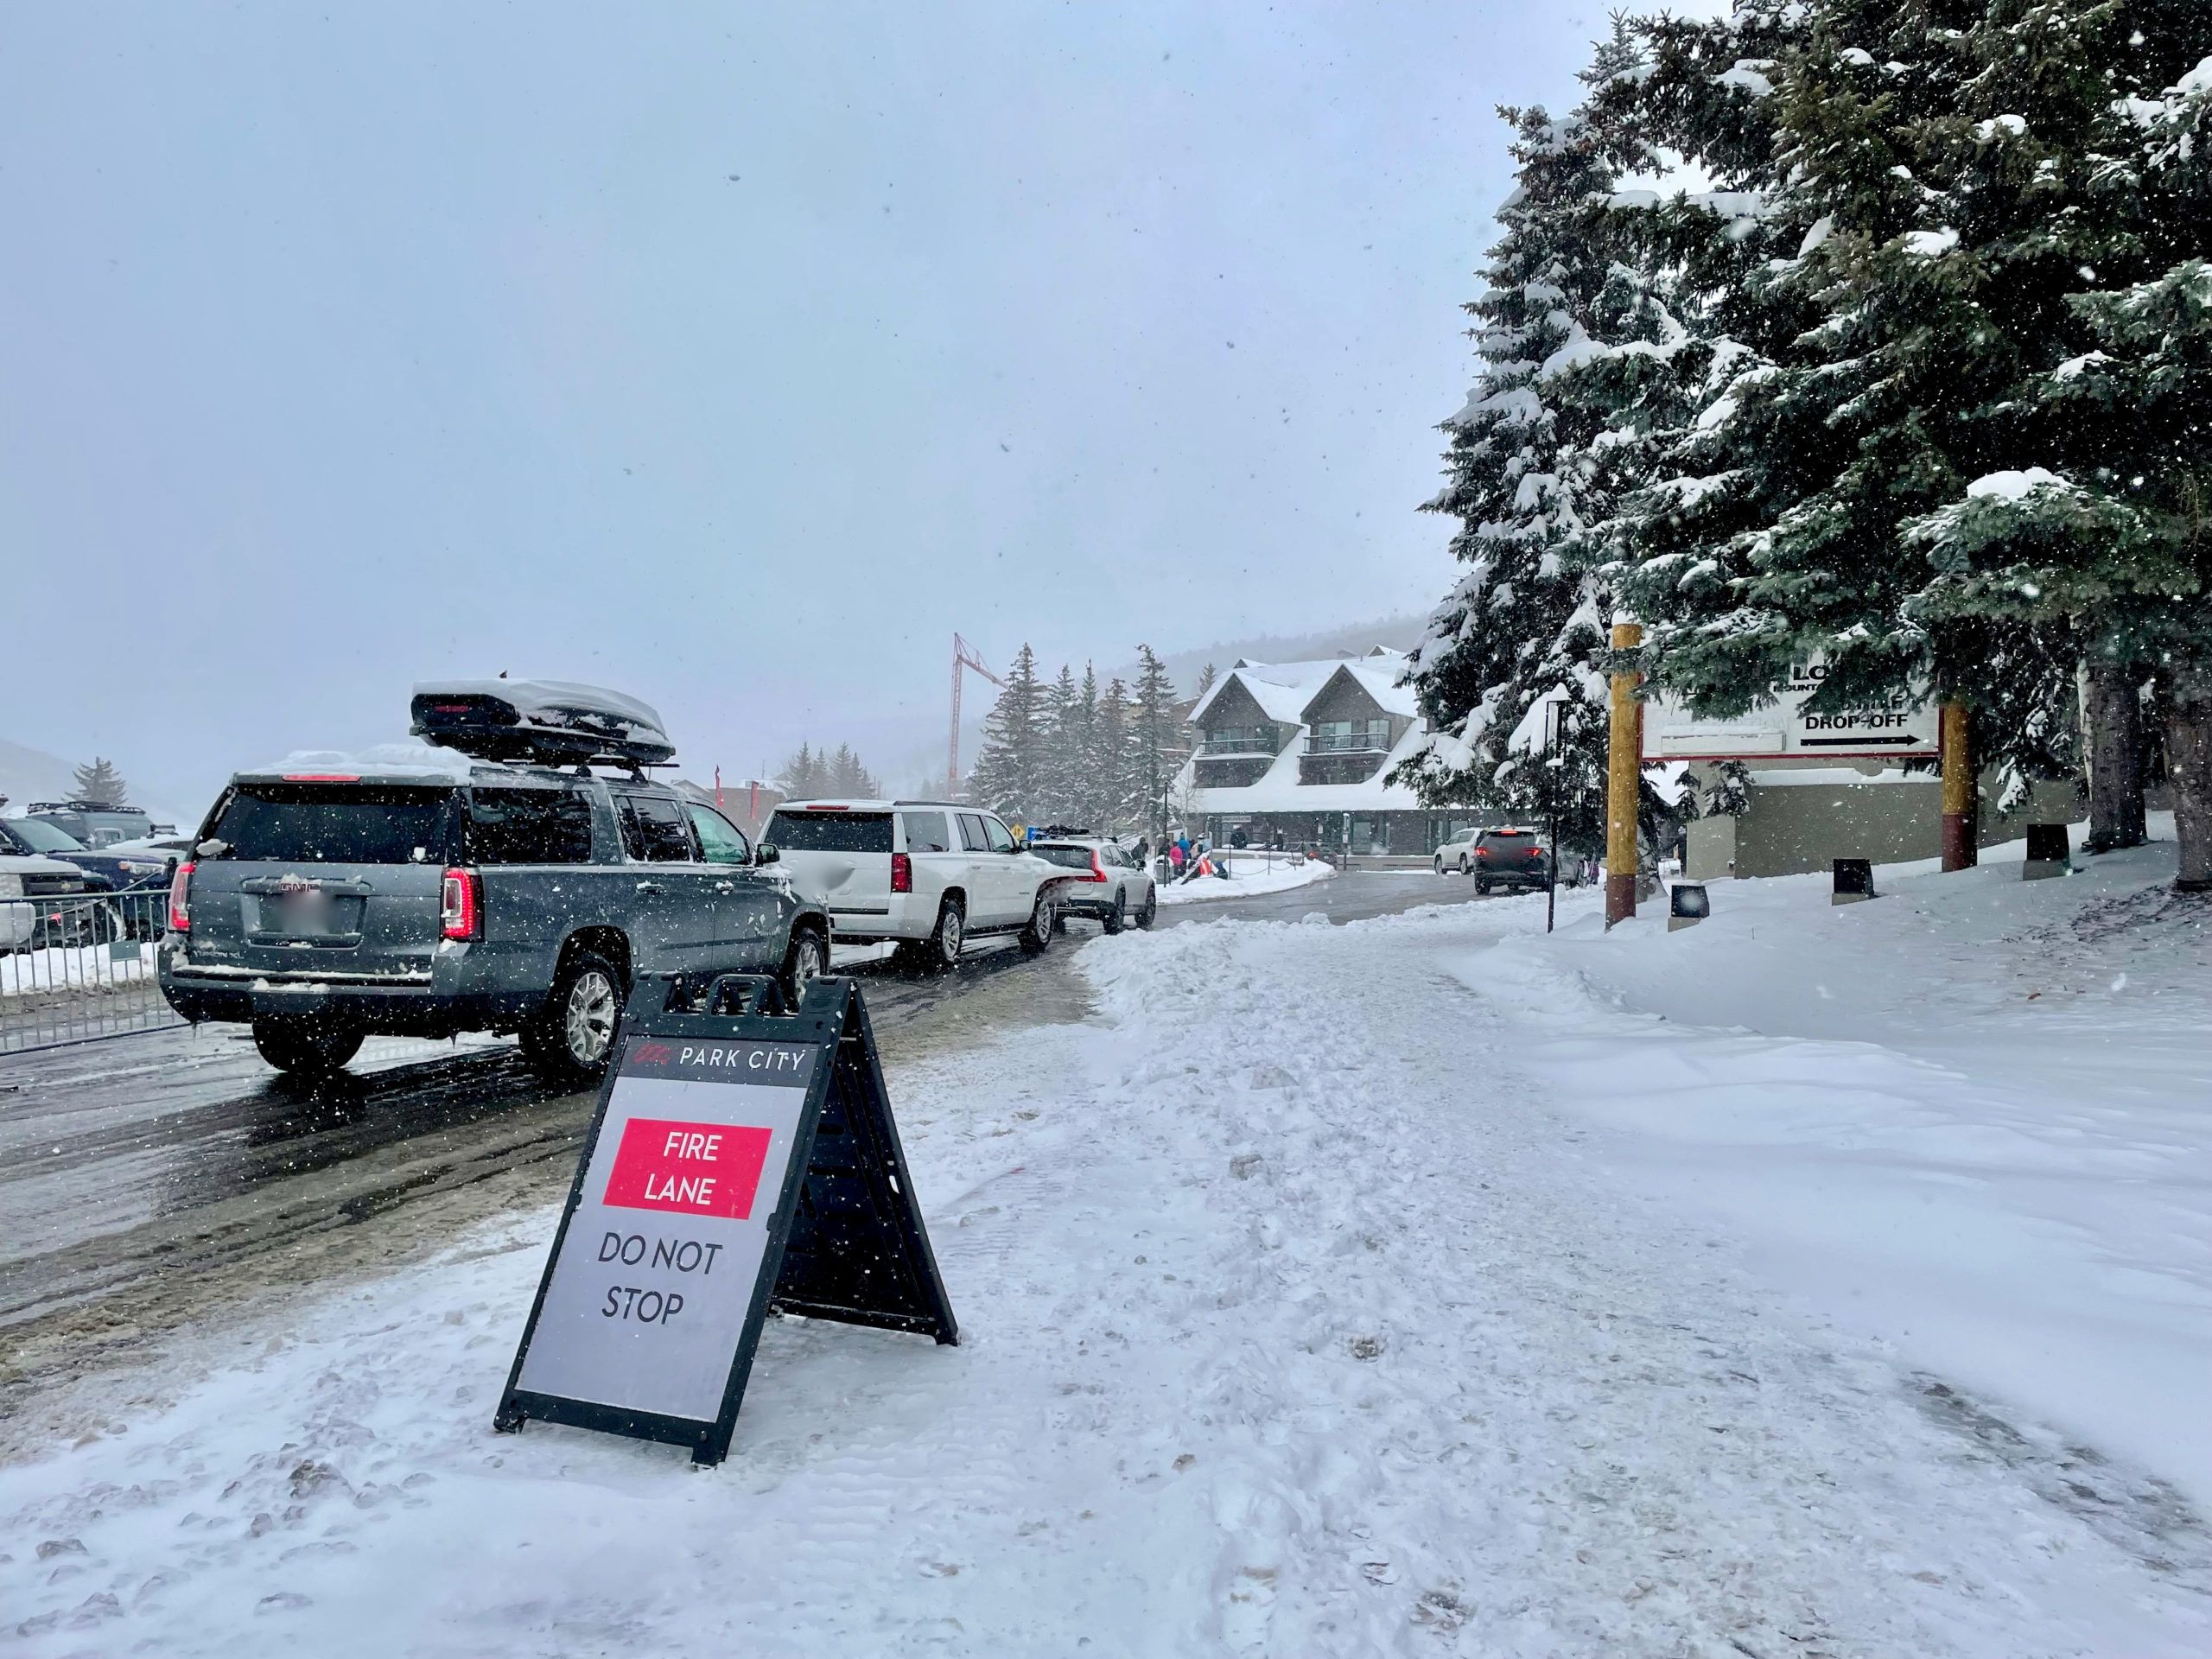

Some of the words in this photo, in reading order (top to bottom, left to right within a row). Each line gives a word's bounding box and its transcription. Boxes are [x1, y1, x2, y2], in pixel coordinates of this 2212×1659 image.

[1805, 714, 1909, 730] DROP-OFF
[281, 882, 321, 893] GMC
[679, 1047, 741, 1068] PARK
[747, 1050, 805, 1071] CITY
[663, 1131, 722, 1161] FIRE
[644, 1173, 716, 1205] LANE
[598, 1231, 646, 1266] DO
[651, 1237, 723, 1274] NOT
[601, 1286, 684, 1325] STOP
